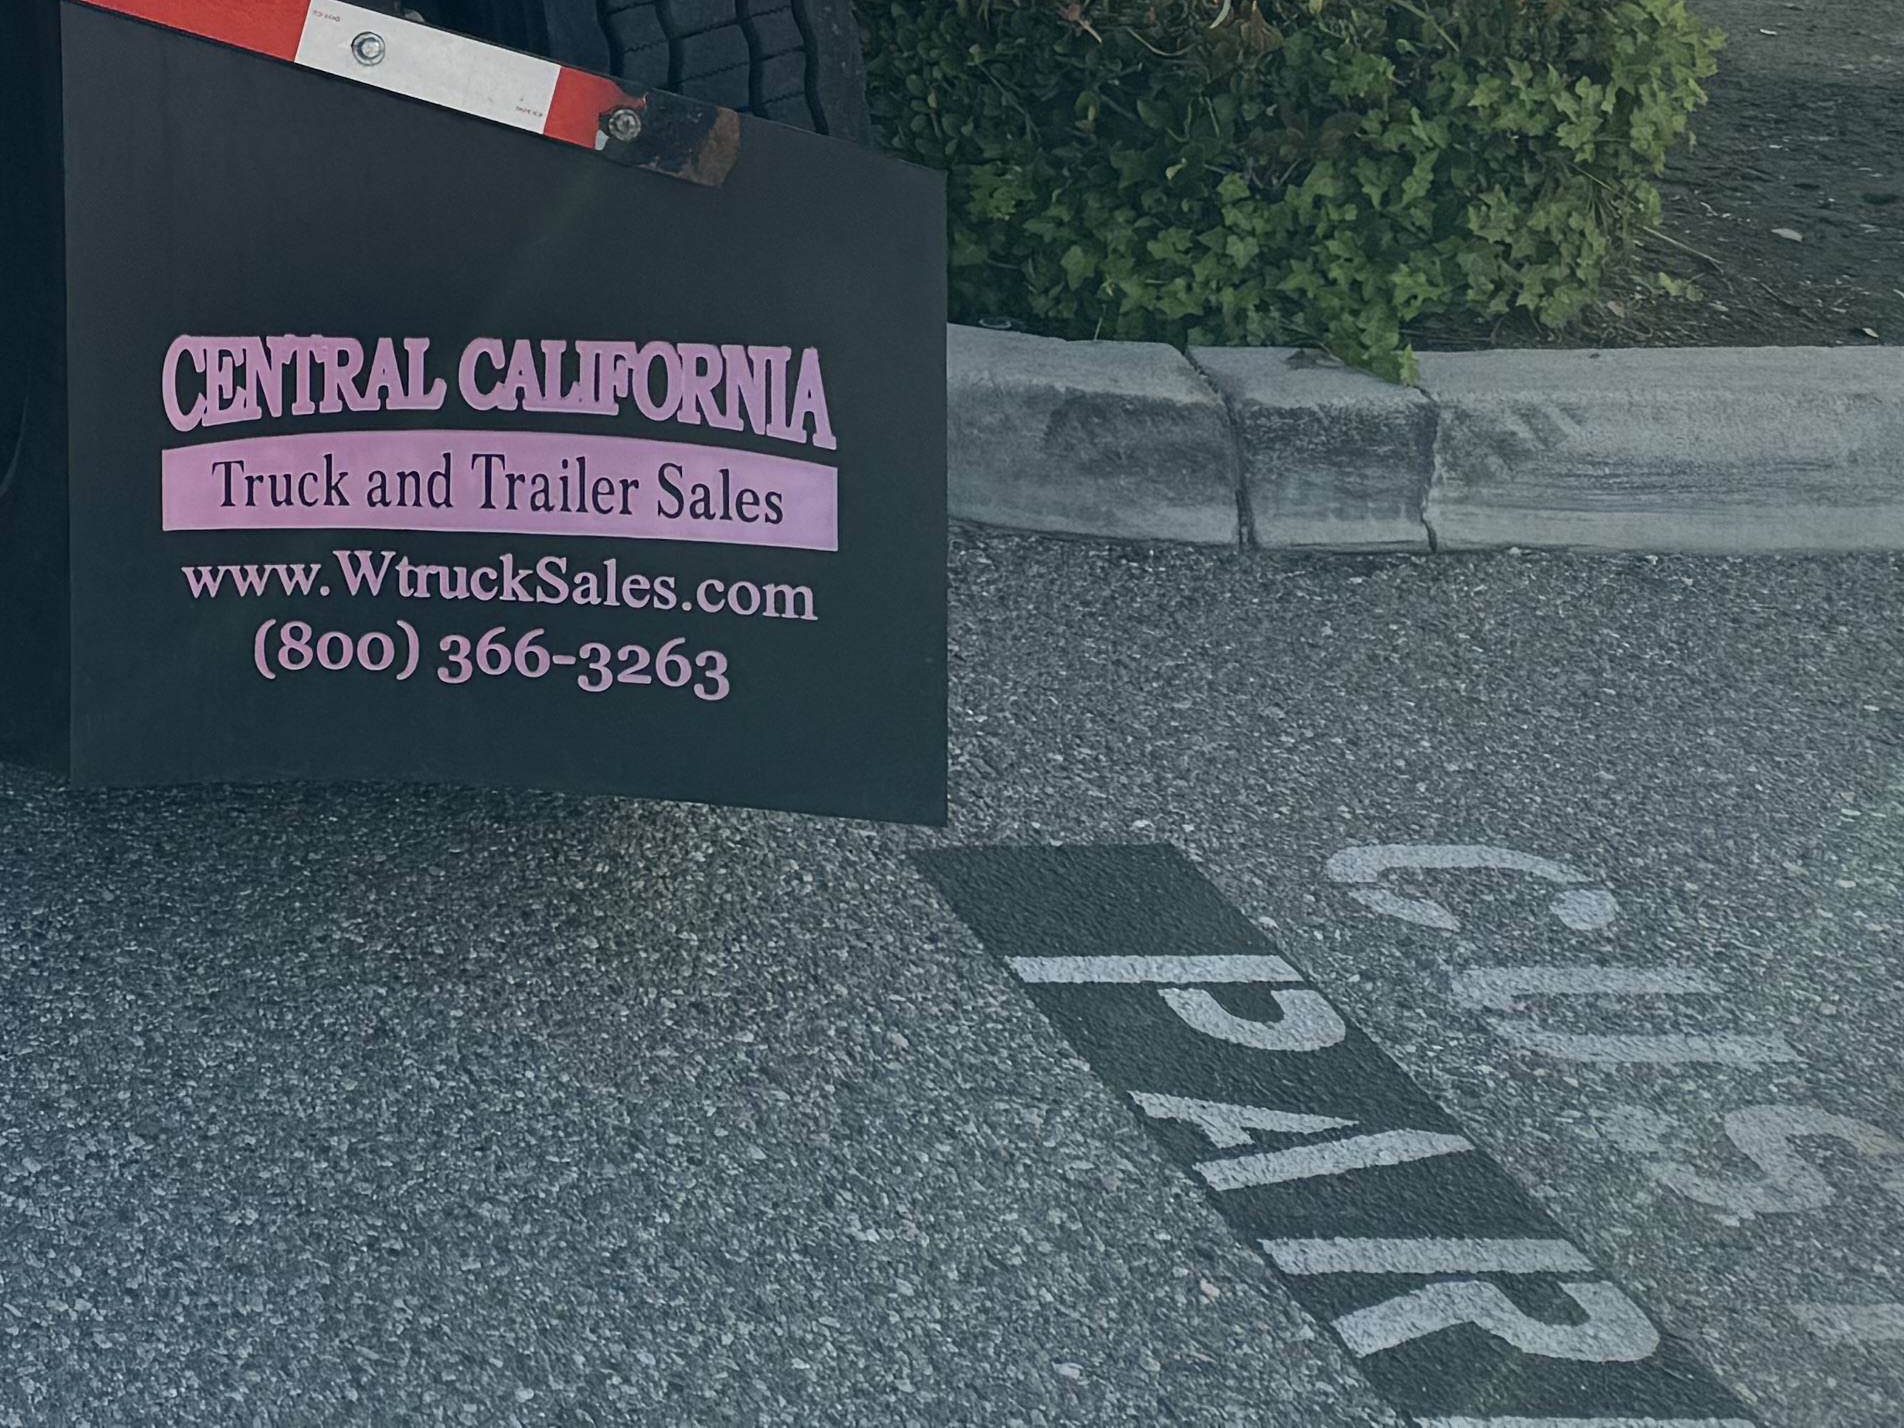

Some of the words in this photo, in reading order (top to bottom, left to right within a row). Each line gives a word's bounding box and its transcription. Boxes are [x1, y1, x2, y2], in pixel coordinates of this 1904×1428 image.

[162, 334, 447, 431] CENTRAL
[458, 337, 837, 450] CALIFORNIA
[212, 454, 349, 507] Truck
[367, 453, 453, 508] and
[472, 454, 639, 515] Trailer
[658, 463, 783, 524] Sales
[182, 549, 819, 622] www.WtruckSales.com
[255, 619, 419, 680] (800)
[438, 627, 729, 700] 366-3263
